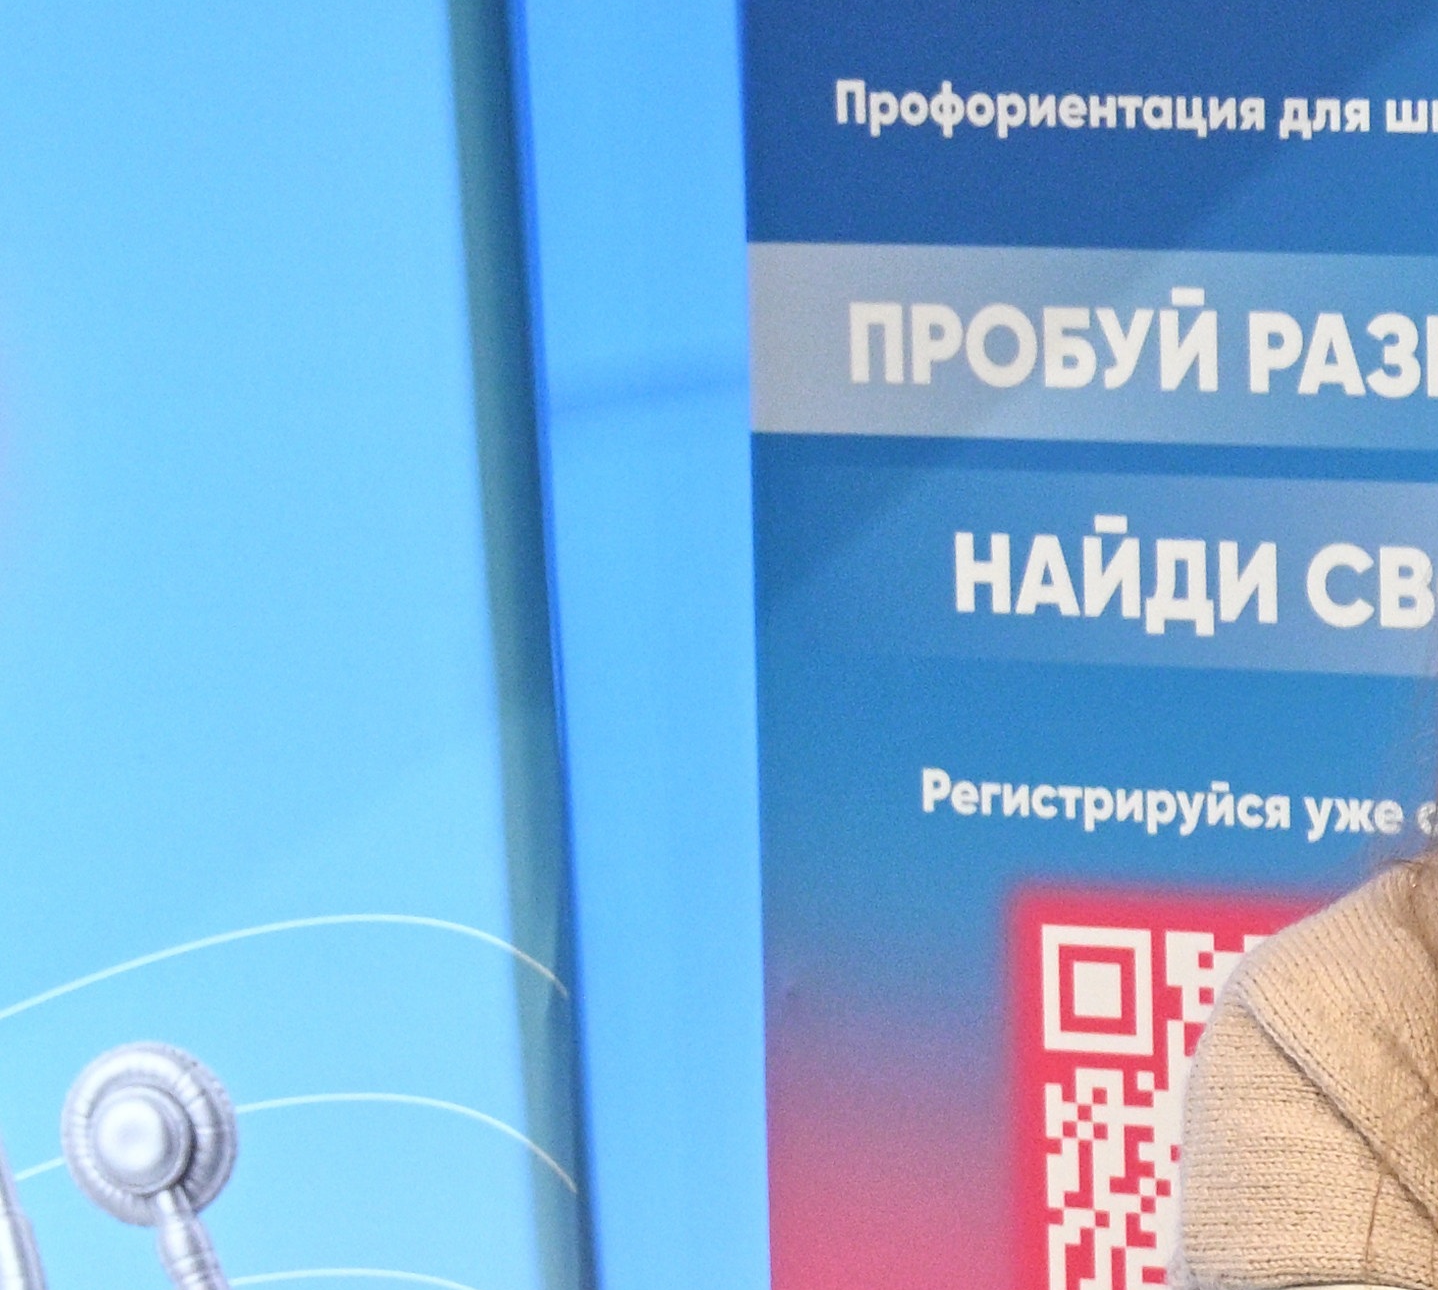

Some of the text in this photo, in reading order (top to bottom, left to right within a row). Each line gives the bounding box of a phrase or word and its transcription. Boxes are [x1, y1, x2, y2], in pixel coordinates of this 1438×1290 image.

[834, 78, 1266, 140] Профориентация
[1278, 96, 1370, 140] для
[847, 287, 1219, 394] ПРОБУЙ
[954, 515, 1279, 636] НАЙДИ
[922, 769, 1291, 836] Регистрируйся
[1303, 796, 1404, 842] уже
